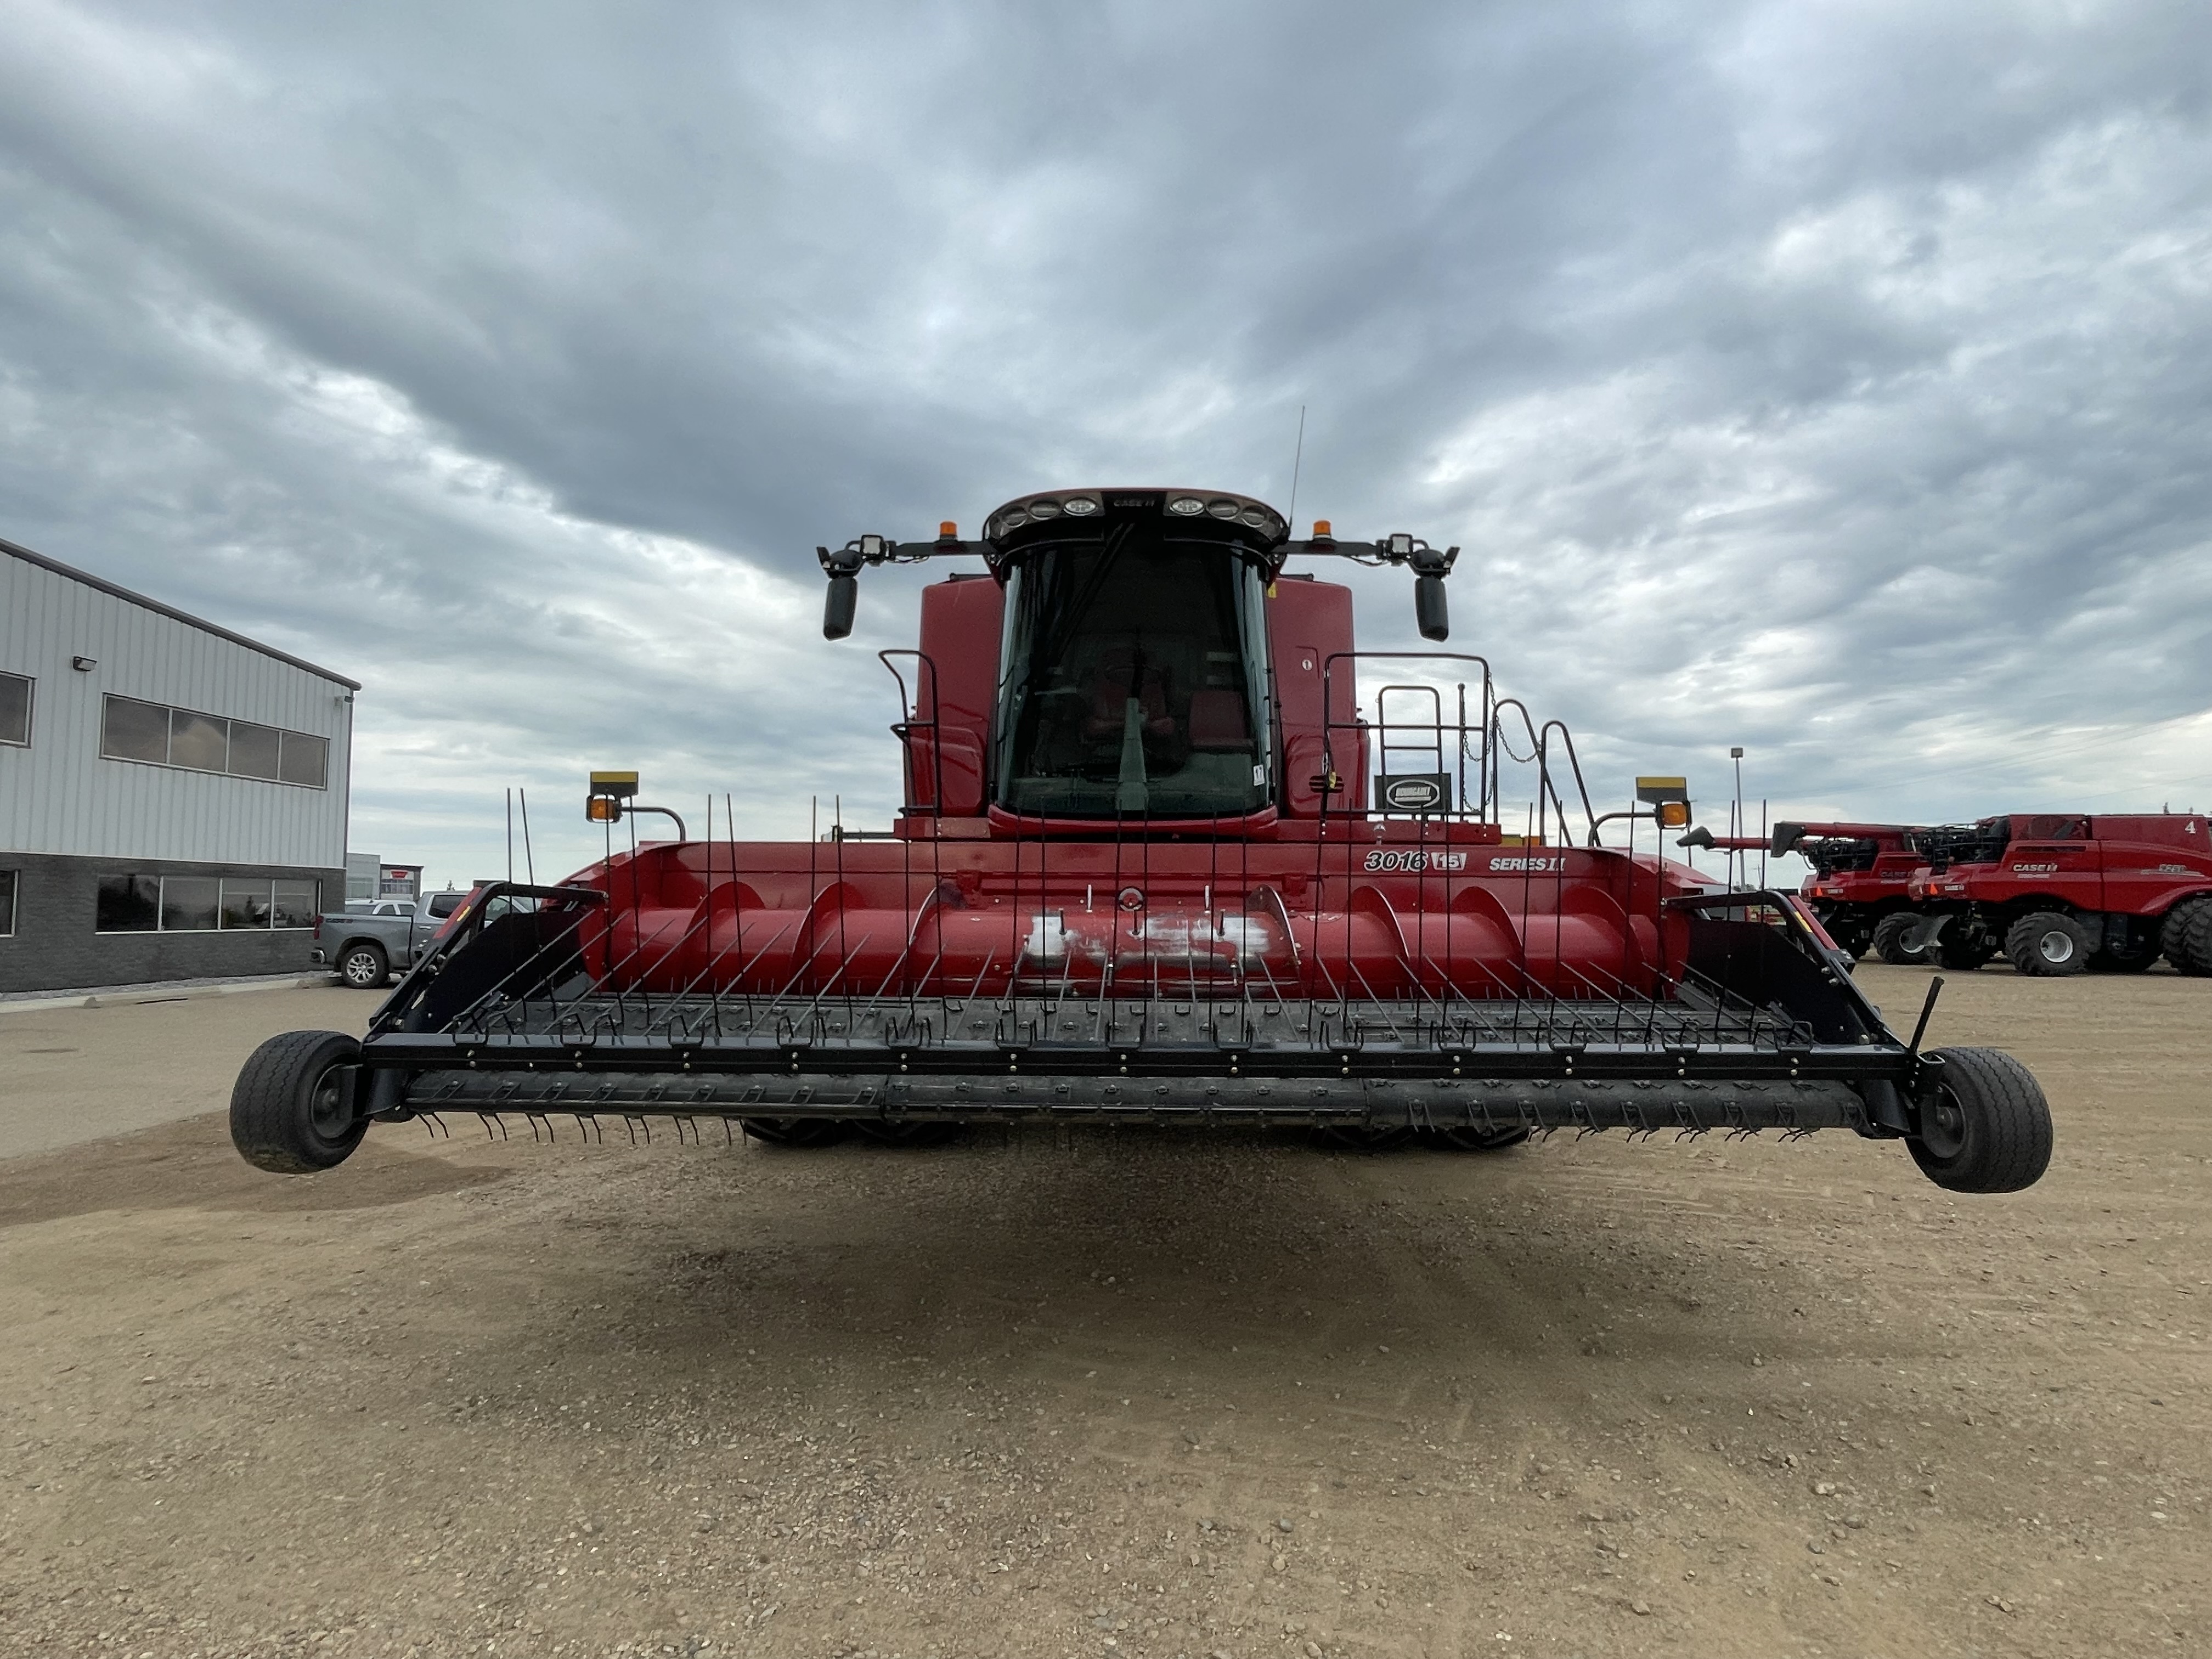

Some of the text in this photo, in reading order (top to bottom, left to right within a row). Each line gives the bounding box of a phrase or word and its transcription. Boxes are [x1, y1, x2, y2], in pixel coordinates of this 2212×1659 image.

[2185, 820, 2196, 834] 4
[1364, 850, 1566, 872] 3016 15 SERIES II
